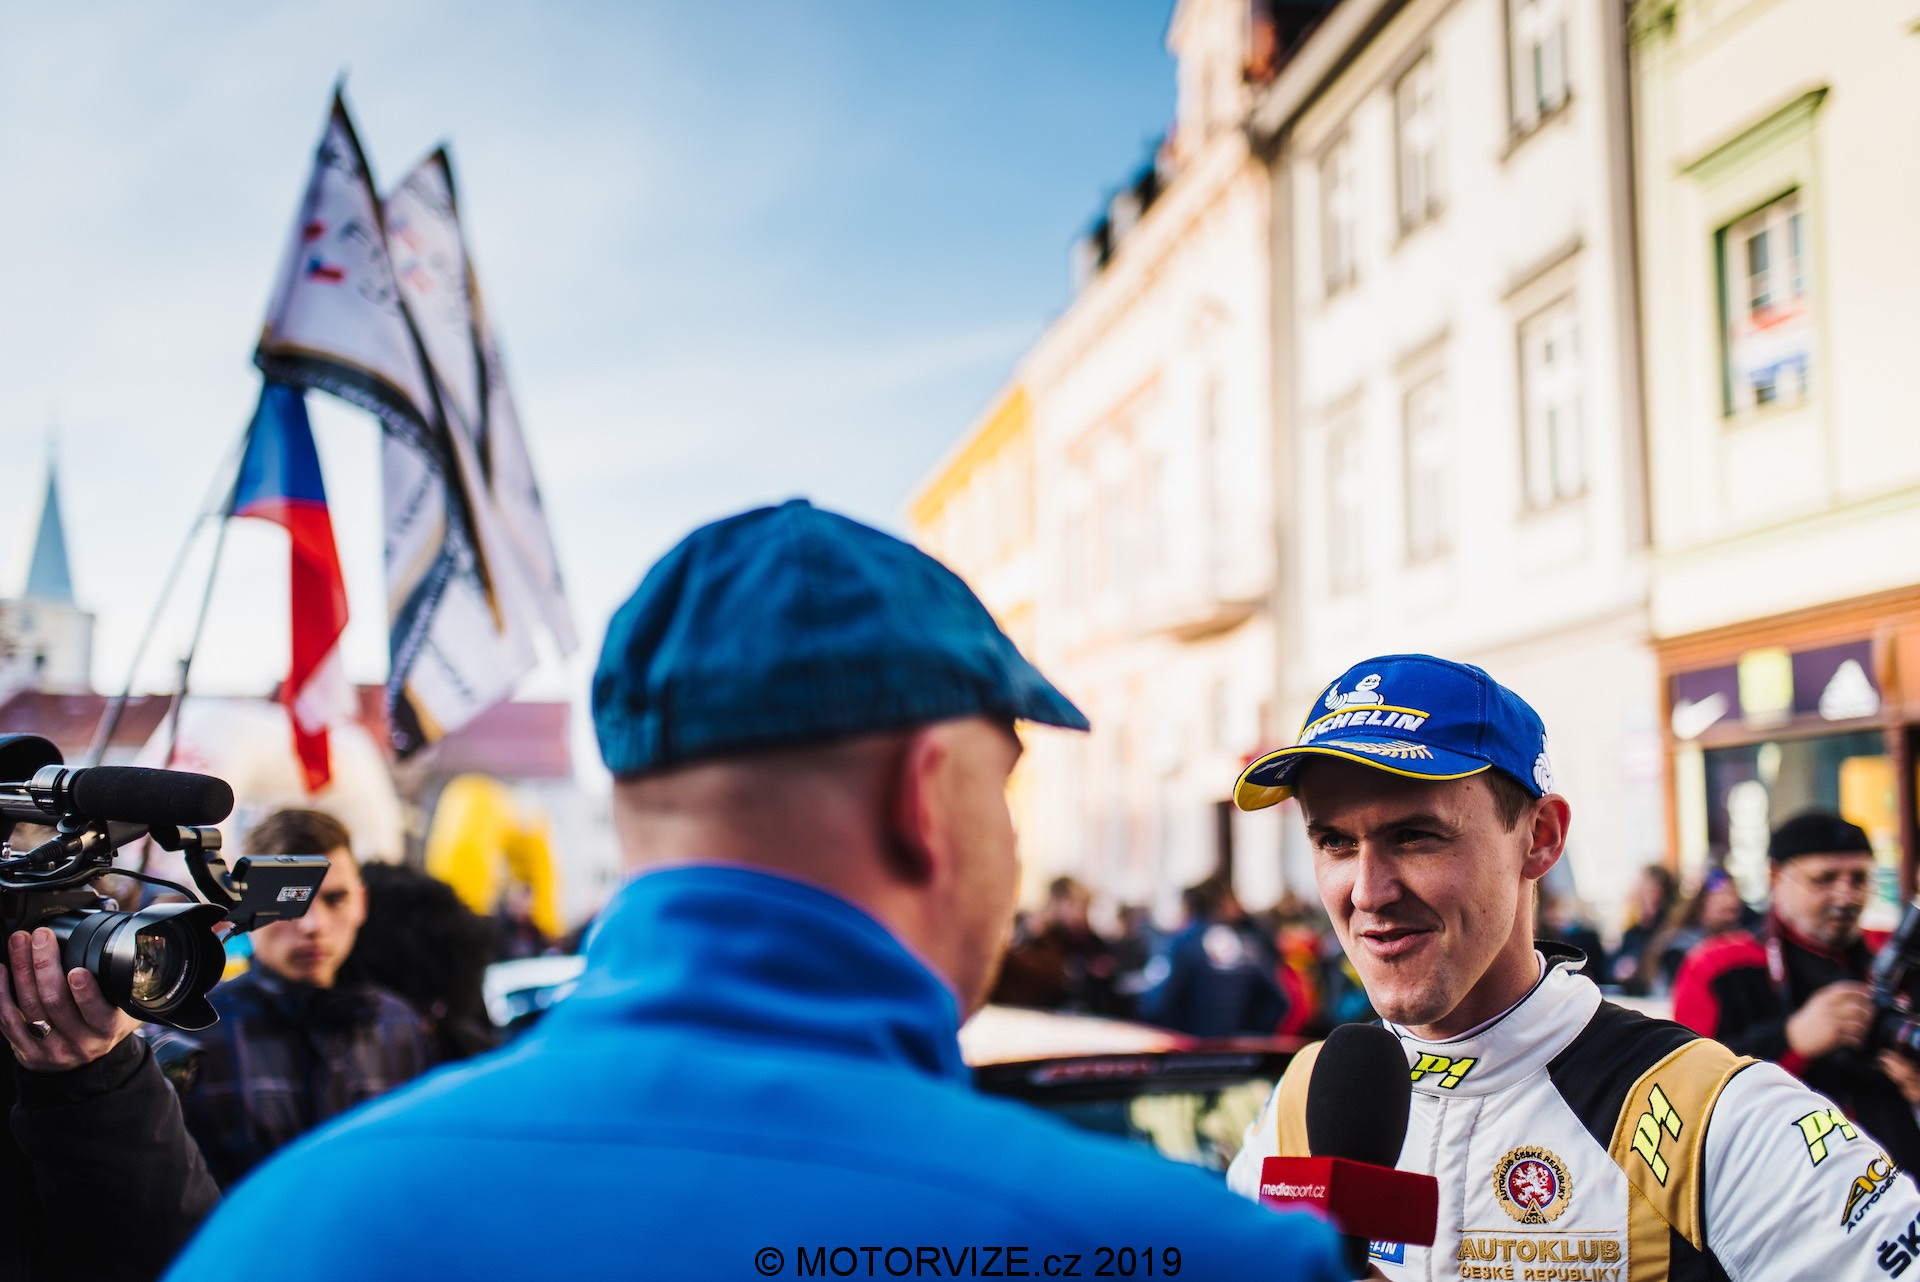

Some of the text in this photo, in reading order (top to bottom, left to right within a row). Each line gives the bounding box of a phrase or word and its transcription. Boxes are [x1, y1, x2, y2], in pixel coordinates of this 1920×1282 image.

[1410, 1051, 1478, 1089] P1
[1630, 1083, 1683, 1187] P1
[1791, 1108, 1857, 1167] P1
[1261, 1182, 1326, 1200] mediasport.cz
[1456, 1237, 1622, 1263] AUTOKLUB
[1876, 1211, 1920, 1280] ŠK
[1458, 1262, 1622, 1282] ČESKÉ REPUBLIKY
